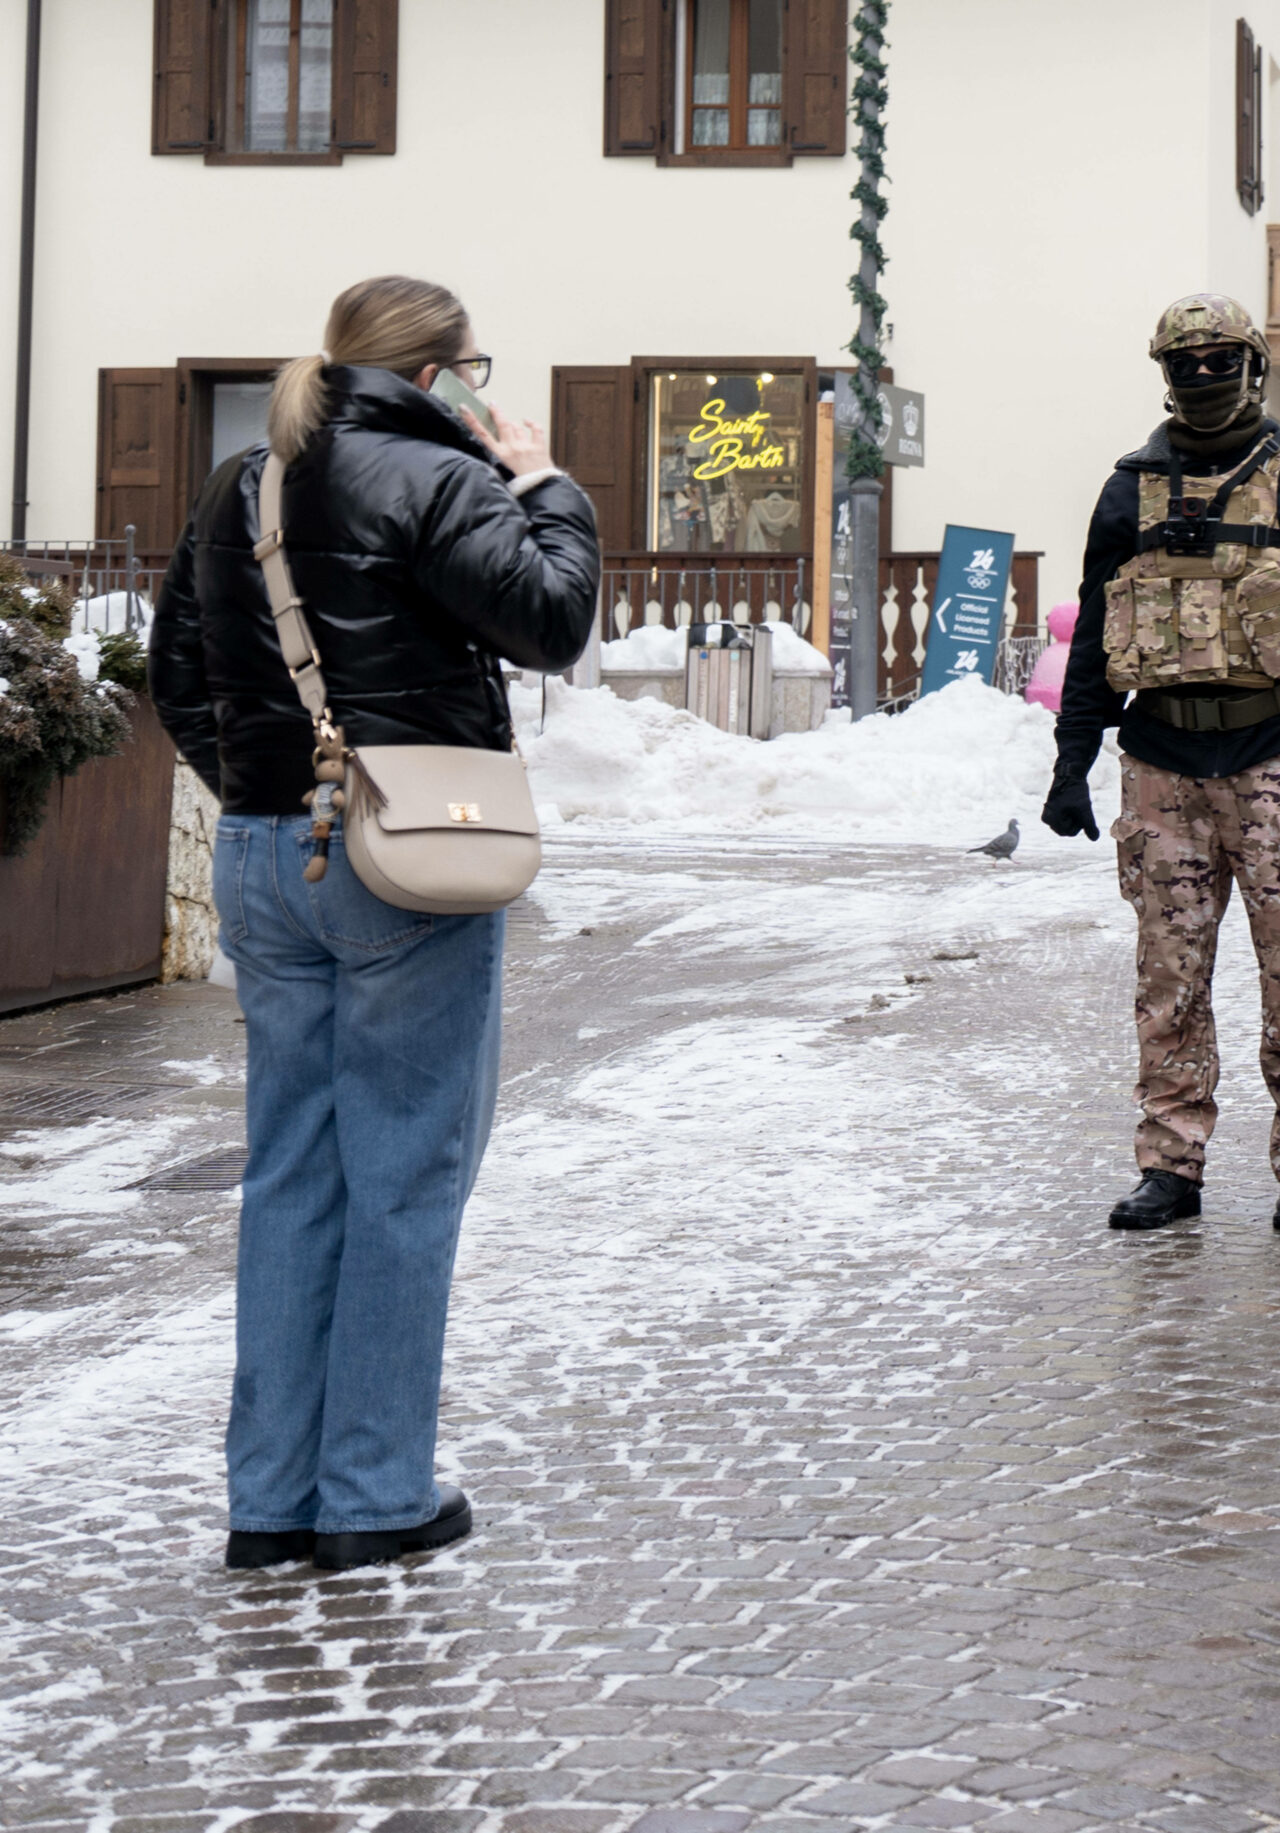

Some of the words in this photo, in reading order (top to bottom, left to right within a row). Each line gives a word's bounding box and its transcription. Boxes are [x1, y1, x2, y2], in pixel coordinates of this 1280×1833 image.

[689, 399, 770, 442] Saint
[694, 438, 784, 480] Barth
[960, 603, 988, 614] Official
[955, 614, 990, 625] Licensed
[953, 624, 988, 636] Products
